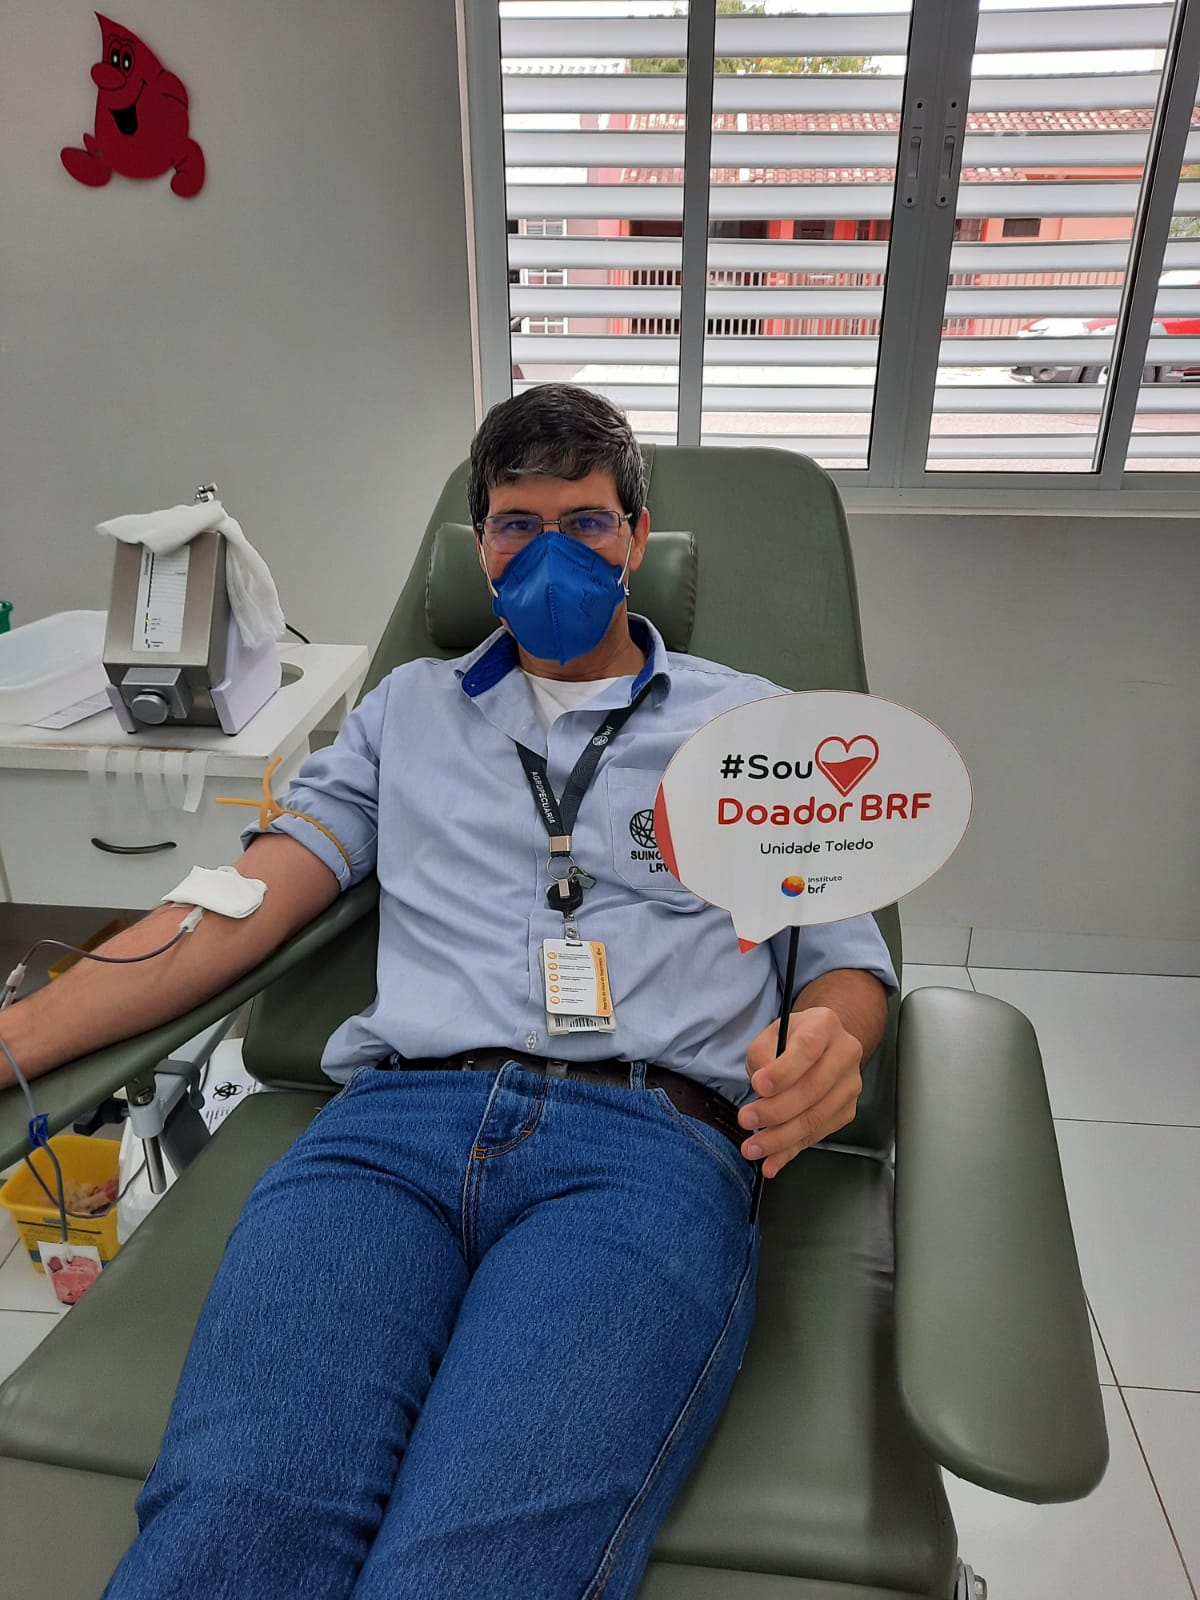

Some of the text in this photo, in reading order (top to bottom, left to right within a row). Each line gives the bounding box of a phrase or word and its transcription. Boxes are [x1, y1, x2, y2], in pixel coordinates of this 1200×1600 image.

[720, 754, 813, 779] #Sou
[718, 793, 932, 826] Doador BRF
[760, 838, 874, 855] Unidade Toledo
[807, 882, 827, 894] brf
